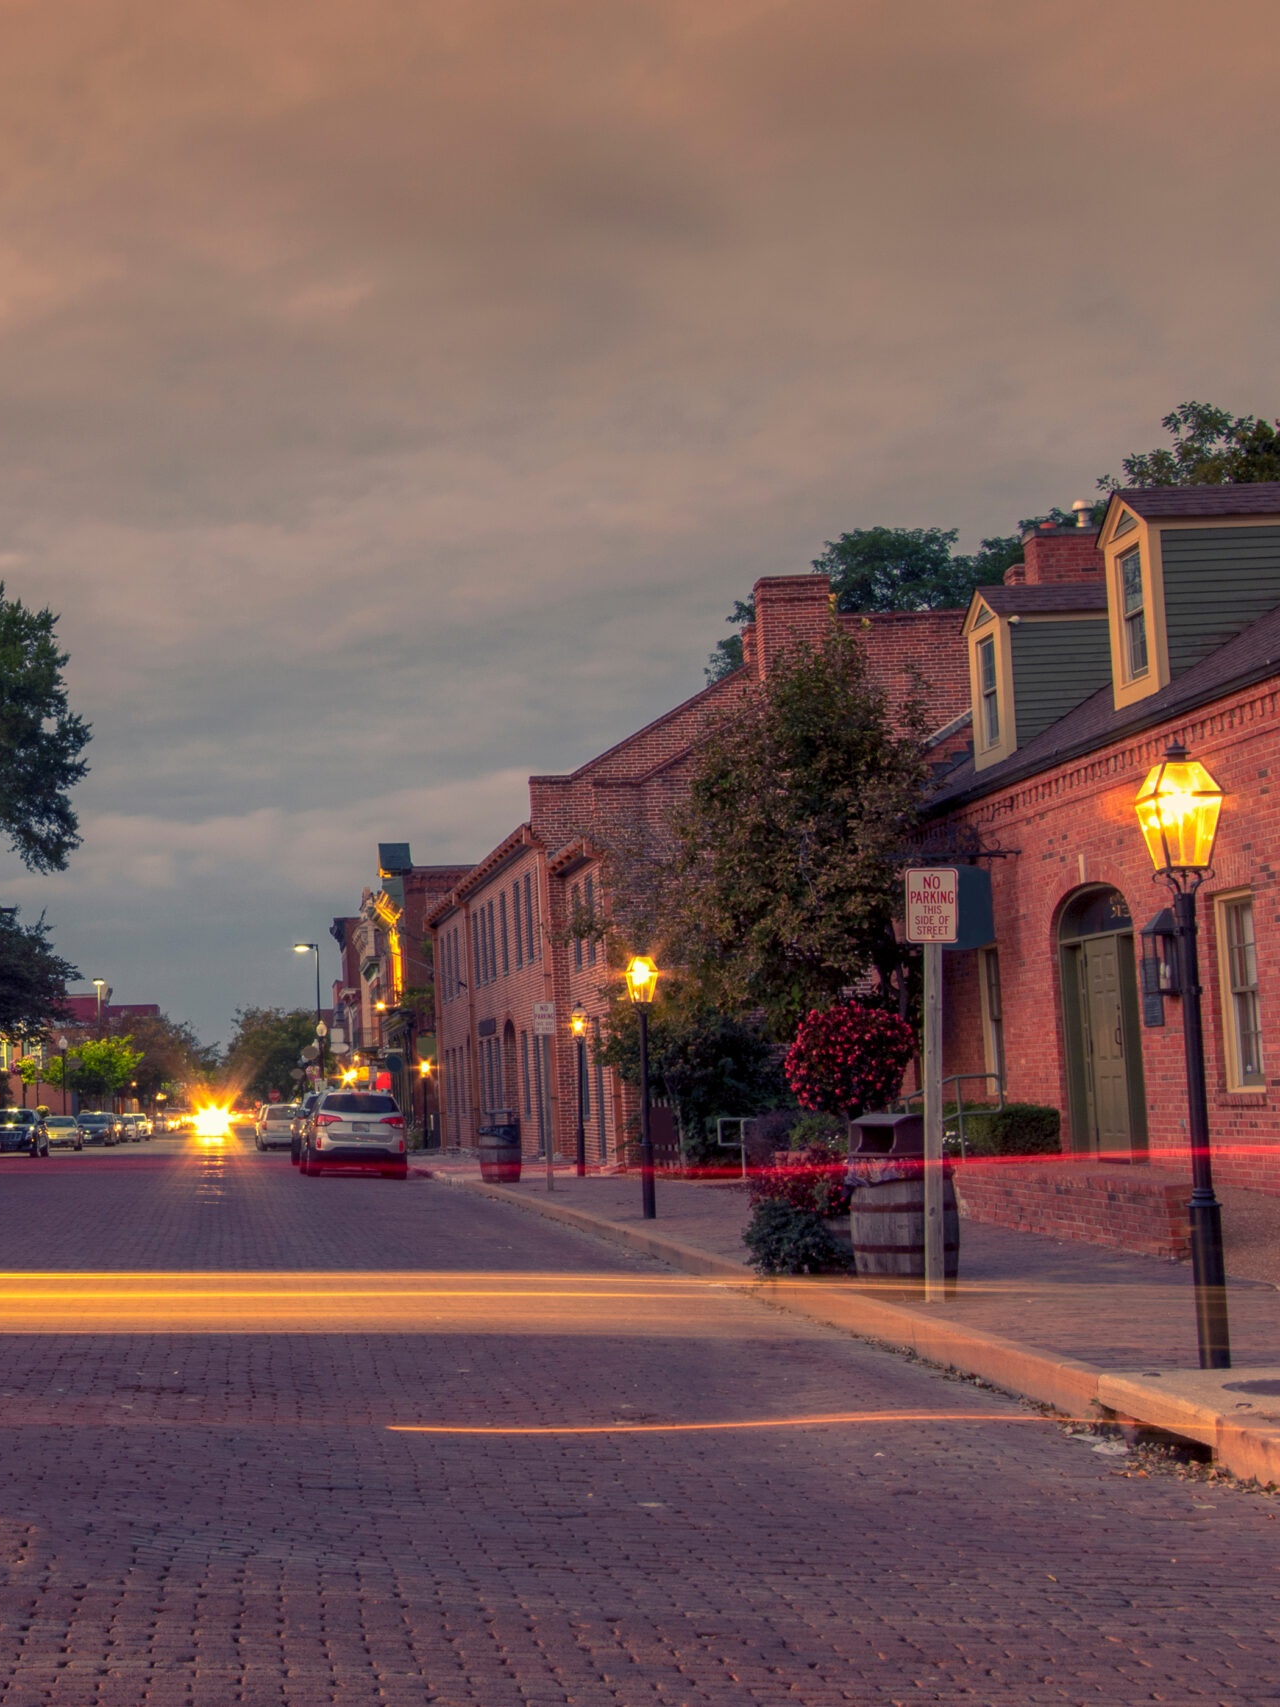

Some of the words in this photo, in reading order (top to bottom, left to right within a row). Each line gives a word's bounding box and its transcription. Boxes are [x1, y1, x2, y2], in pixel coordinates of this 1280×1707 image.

[923, 876, 941, 890] NO
[910, 891, 954, 905] PARKING
[923, 905, 943, 915] THIS
[915, 915, 935, 925] SIDE
[938, 915, 951, 925] OF
[917, 925, 949, 936] STREET
